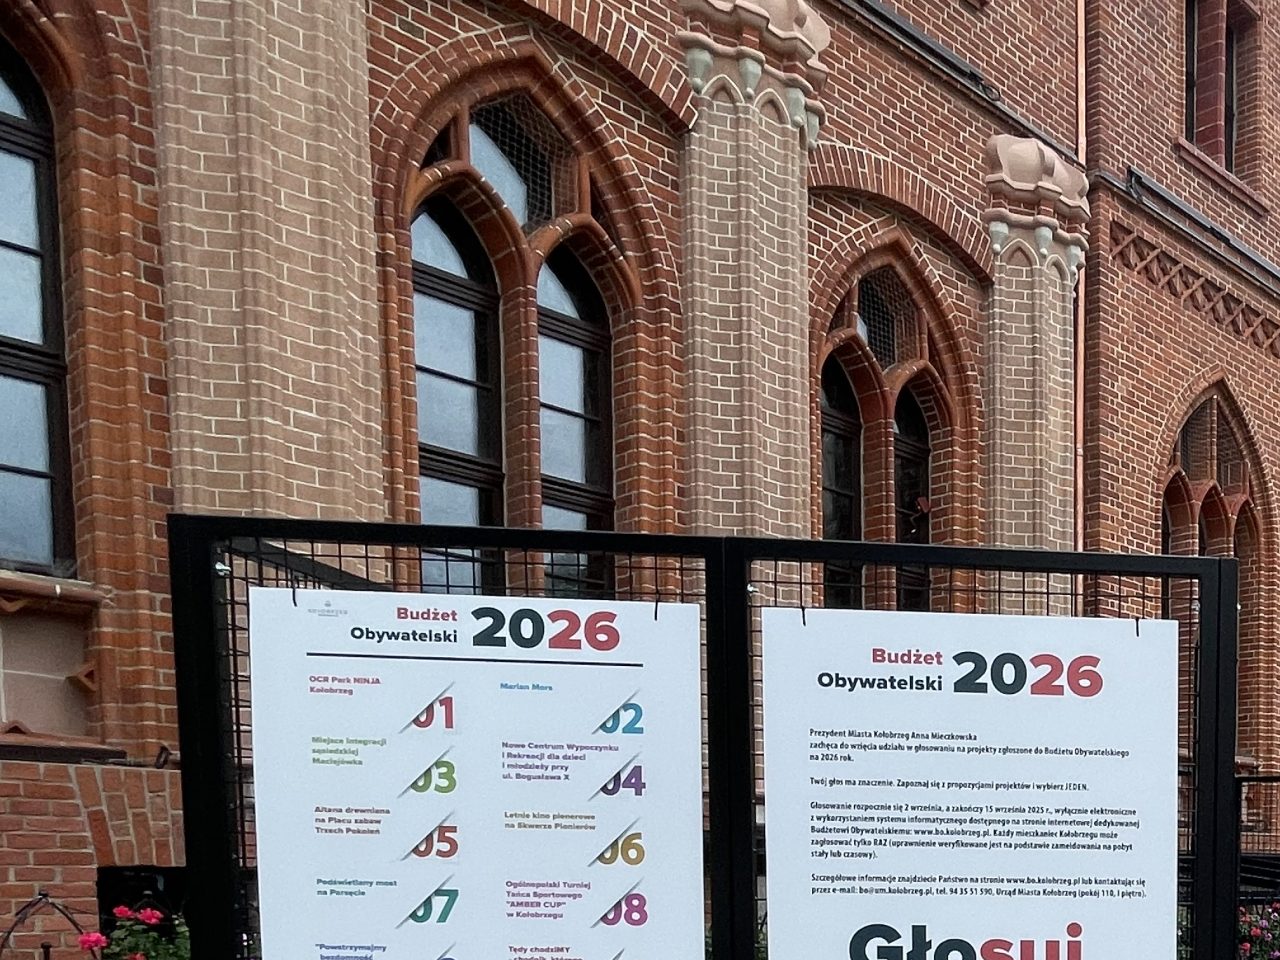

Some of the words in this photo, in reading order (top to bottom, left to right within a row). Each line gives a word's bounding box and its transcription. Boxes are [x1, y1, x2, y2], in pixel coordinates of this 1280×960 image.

[396, 606, 458, 622] Budżet
[470, 606, 621, 652] 2026
[350, 626, 458, 644] Obywatelski
[872, 647, 943, 666] Budżet
[817, 672, 943, 693] Obywatelski
[951, 650, 1104, 698] 2026
[413, 696, 454, 729] 01
[600, 702, 644, 734] 02
[410, 759, 457, 794] 03
[601, 765, 646, 797] 04
[412, 825, 459, 858] 05
[597, 832, 646, 866] 06
[409, 888, 459, 924] 07
[948, 887, 958, 895] 94
[959, 887, 968, 895] 35
[969, 887, 978, 895] 51
[600, 892, 649, 927] 08
